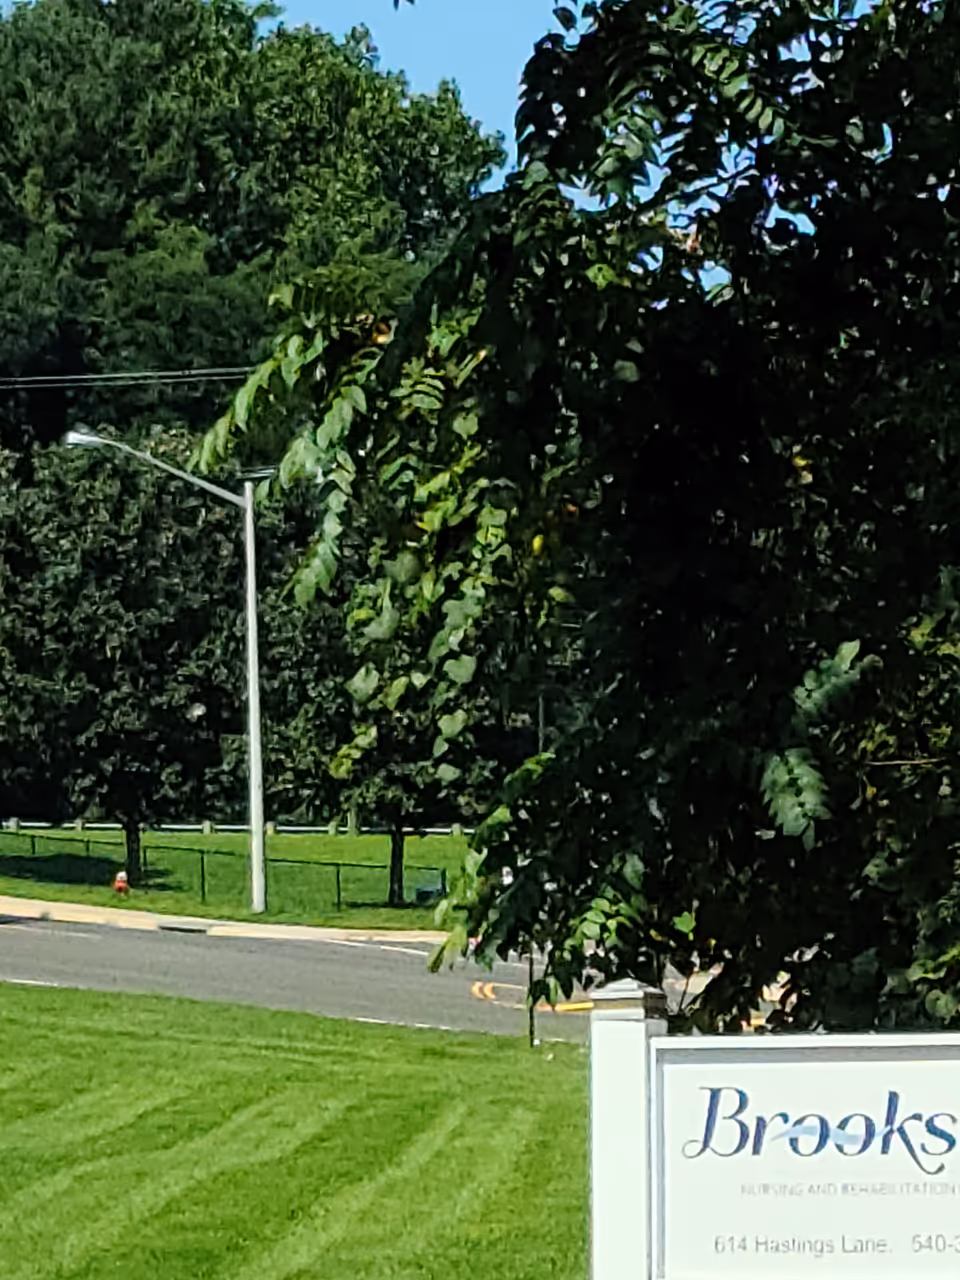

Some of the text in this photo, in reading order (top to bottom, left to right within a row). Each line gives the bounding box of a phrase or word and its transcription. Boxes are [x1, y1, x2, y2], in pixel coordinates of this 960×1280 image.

[740, 1182, 803, 1197] NURSING
[807, 1182, 838, 1196] AND
[840, 1181, 955, 1196] REHABILITATION
[714, 1236, 748, 1254] 614
[754, 1235, 836, 1258] Hastings
